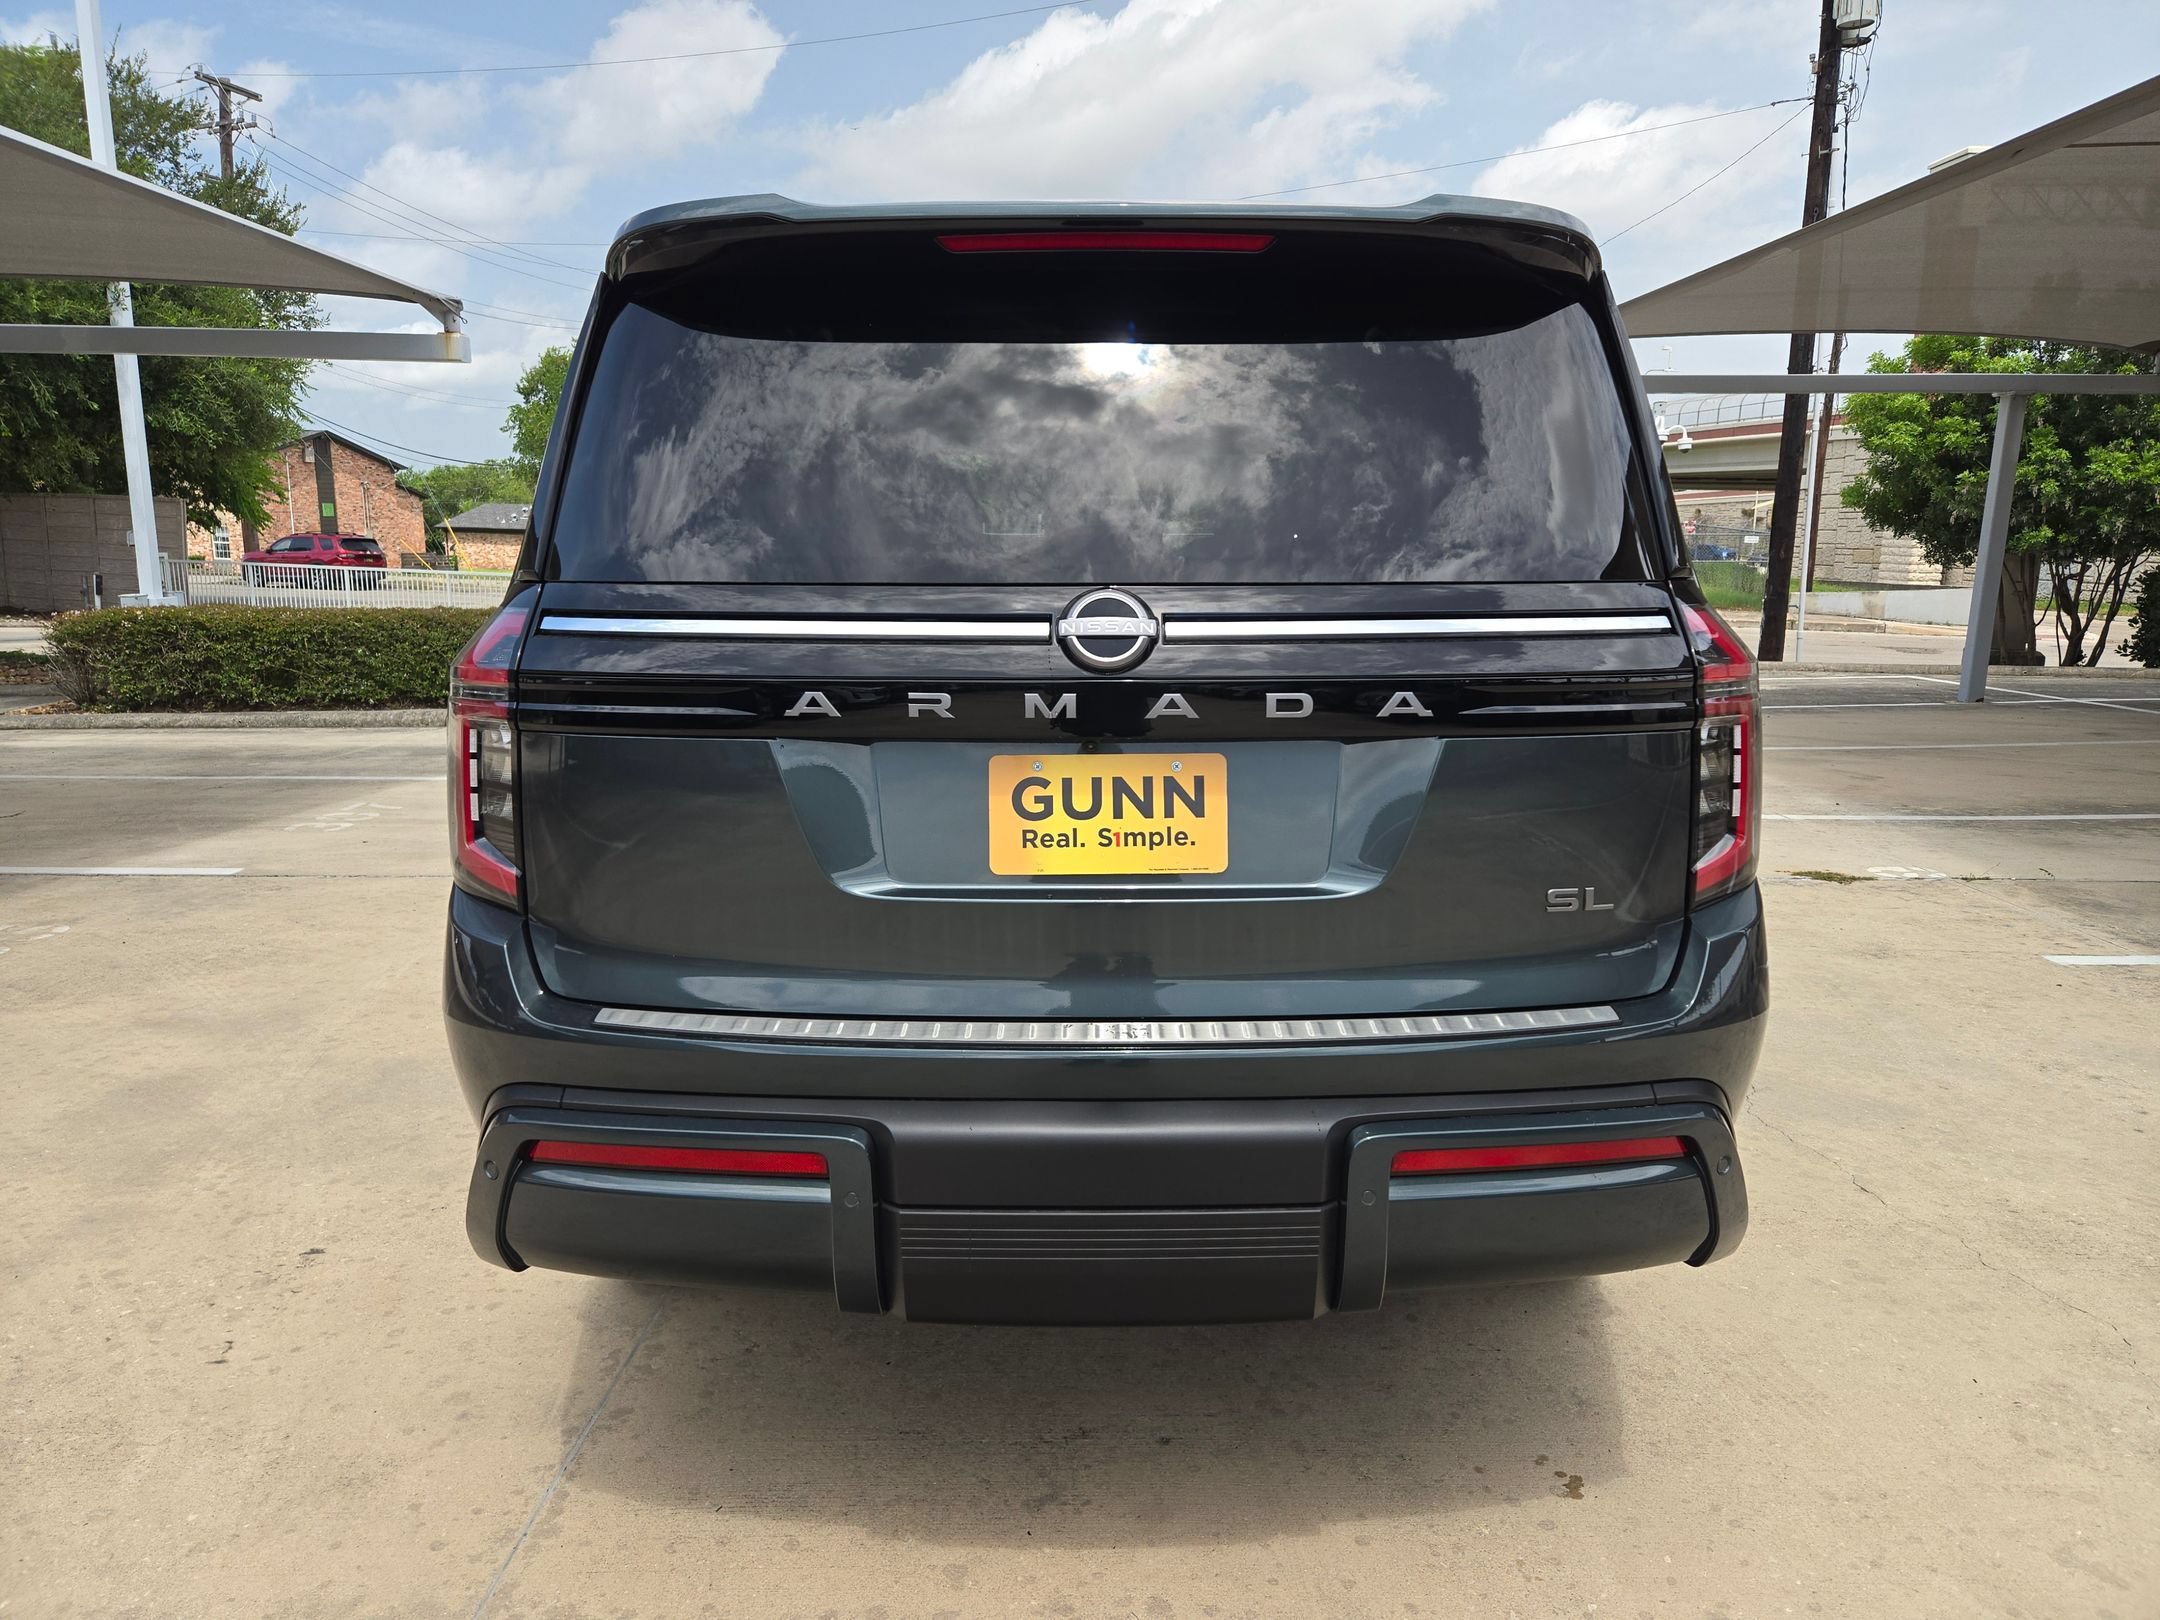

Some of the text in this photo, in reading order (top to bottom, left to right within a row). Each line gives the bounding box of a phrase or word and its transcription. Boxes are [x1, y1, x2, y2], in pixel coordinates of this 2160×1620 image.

[1061, 621, 1155, 634] NISSAN
[784, 691, 1434, 719] ARMADA
[1011, 775, 1206, 822] GUNN
[1022, 827, 1086, 849] Real.
[1545, 887, 1615, 912] SL
